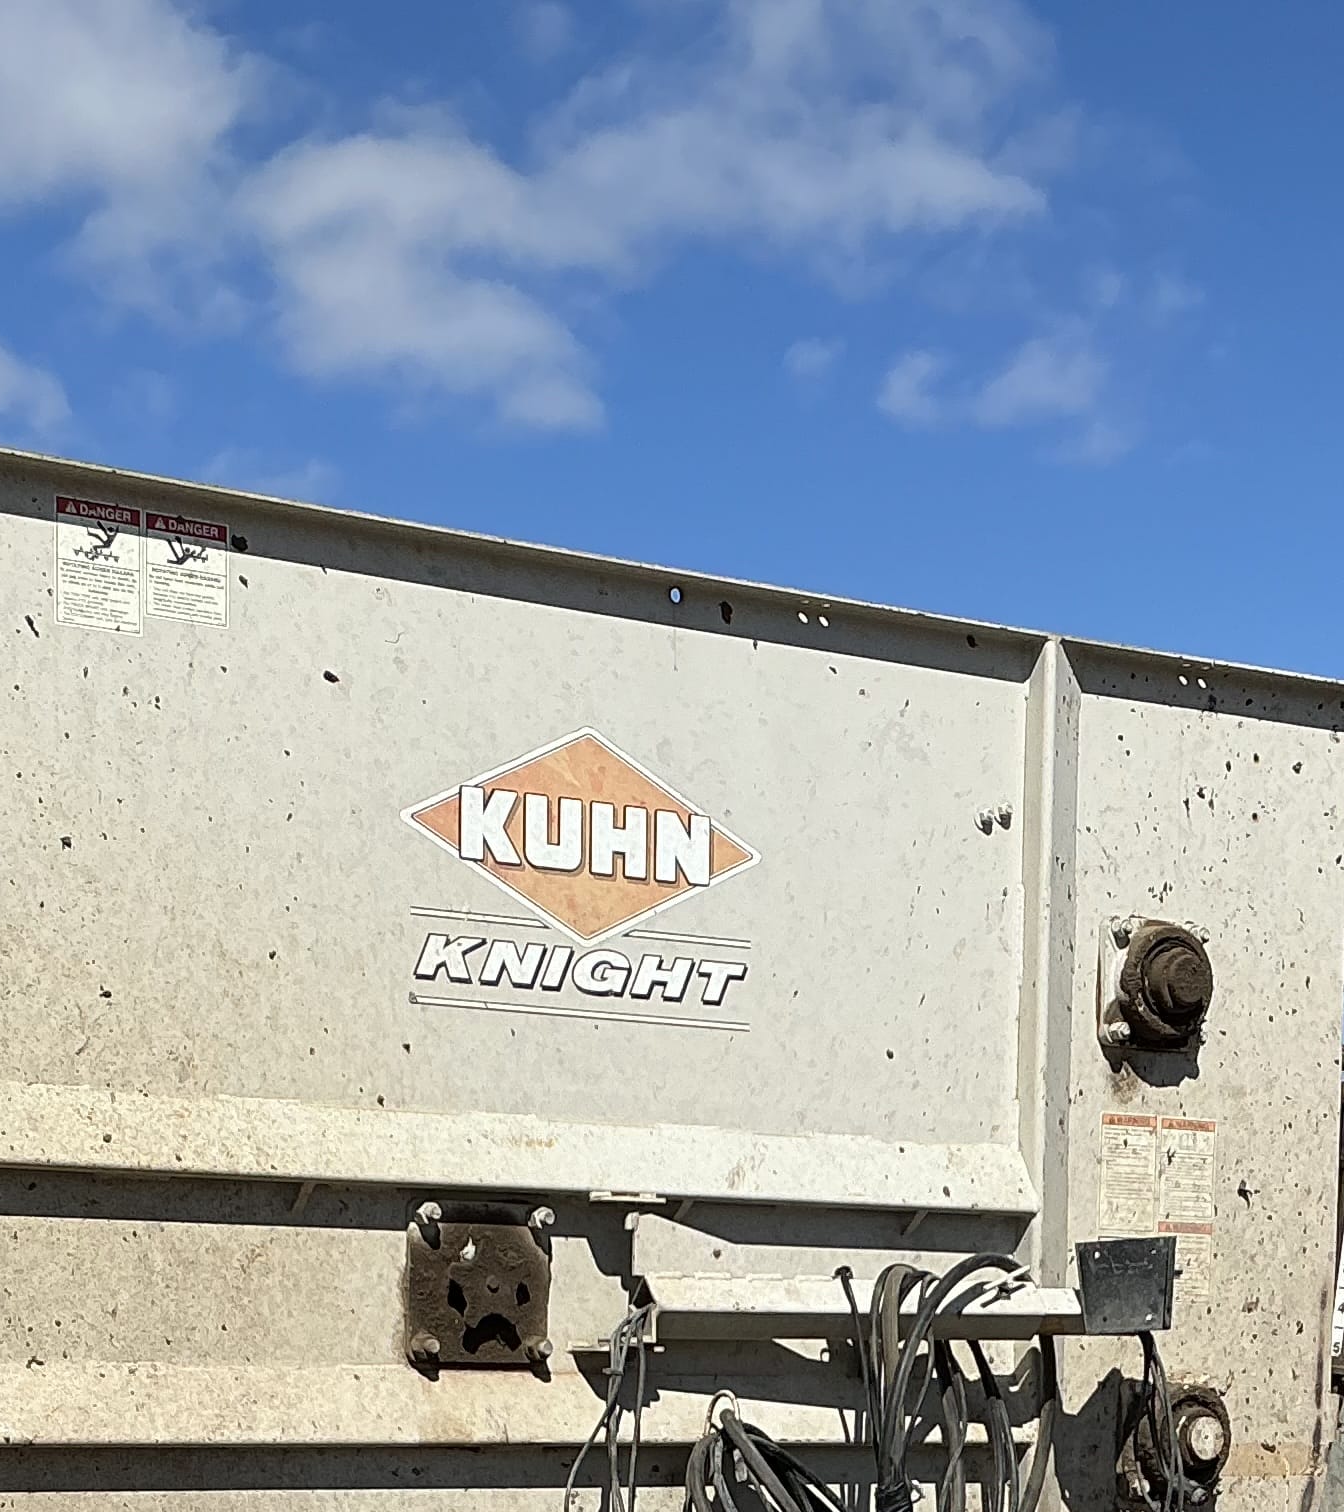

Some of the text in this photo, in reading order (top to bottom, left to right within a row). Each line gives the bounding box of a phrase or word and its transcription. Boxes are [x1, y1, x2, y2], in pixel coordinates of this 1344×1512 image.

[80, 504, 132, 522] DANGER
[169, 521, 219, 539] DANGER
[459, 785, 711, 887] KUHN
[413, 933, 748, 1006] KNIGHT
[1337, 1302, 1344, 1314] 4
[1332, 1342, 1341, 1354] 5
